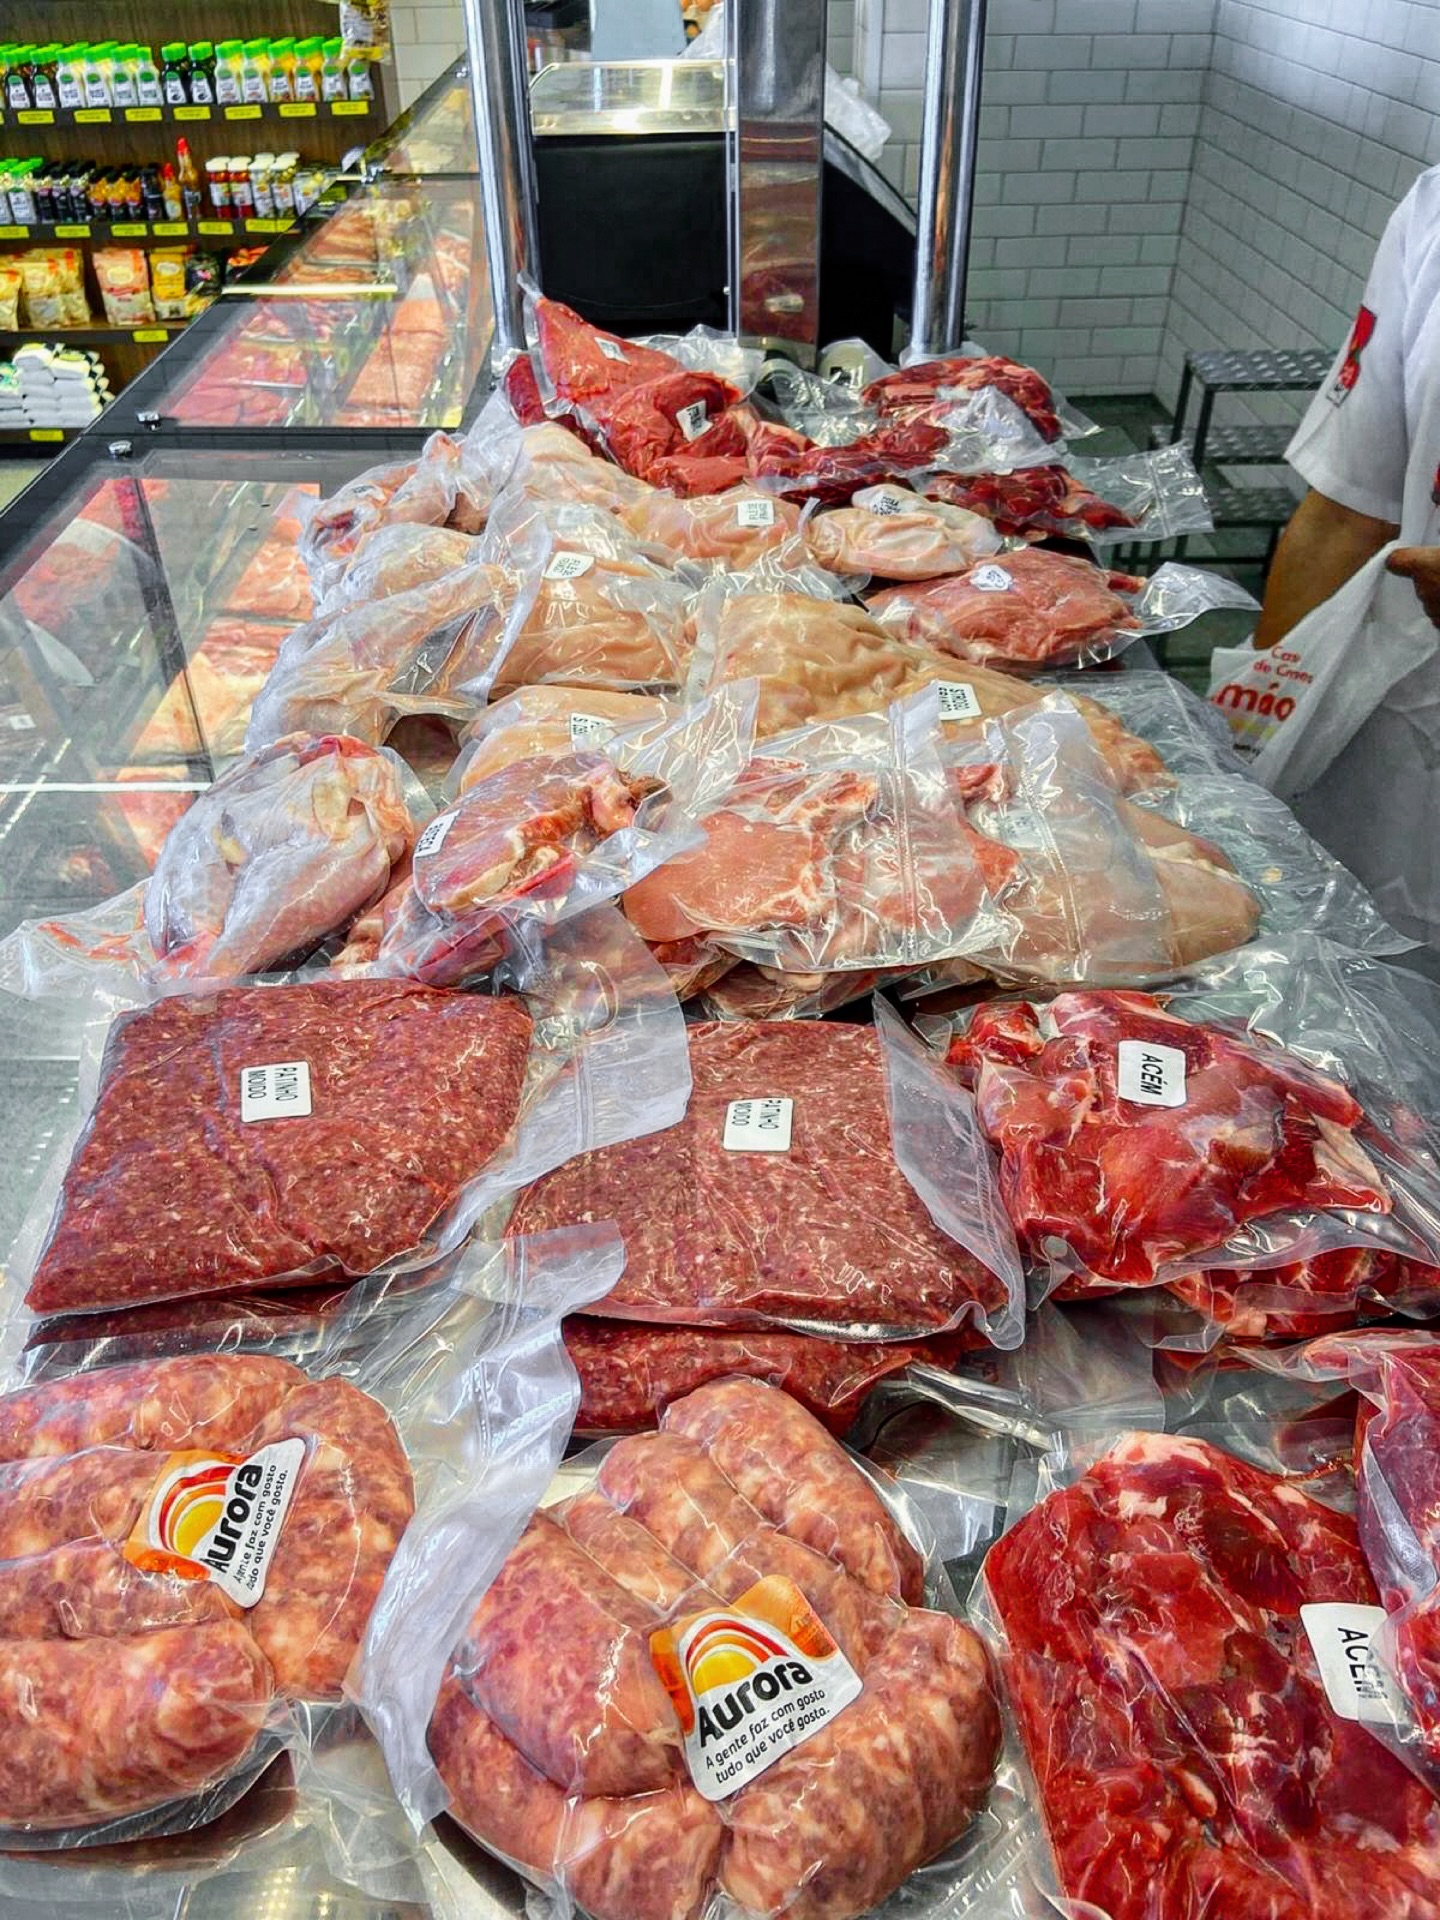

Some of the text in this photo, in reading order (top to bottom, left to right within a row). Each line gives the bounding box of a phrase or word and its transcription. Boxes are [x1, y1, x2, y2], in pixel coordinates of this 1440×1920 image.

[274, 1067, 298, 1101] PATINHO
[758, 1099, 782, 1129] PATINHO
[1140, 1053, 1168, 1096] ACÉM
[199, 1464, 264, 1574] Aurora
[245, 1531, 259, 1550] faz
[254, 1501, 266, 1525] com
[262, 1465, 276, 1497] gosto
[254, 1540, 266, 1564] que
[262, 1509, 276, 1537] você
[271, 1469, 288, 1507] gosta.
[697, 1660, 814, 1748] Aurora
[705, 1689, 826, 1770] A gente faz com gosto
[715, 1708, 831, 1784] tudo que você gosta.
